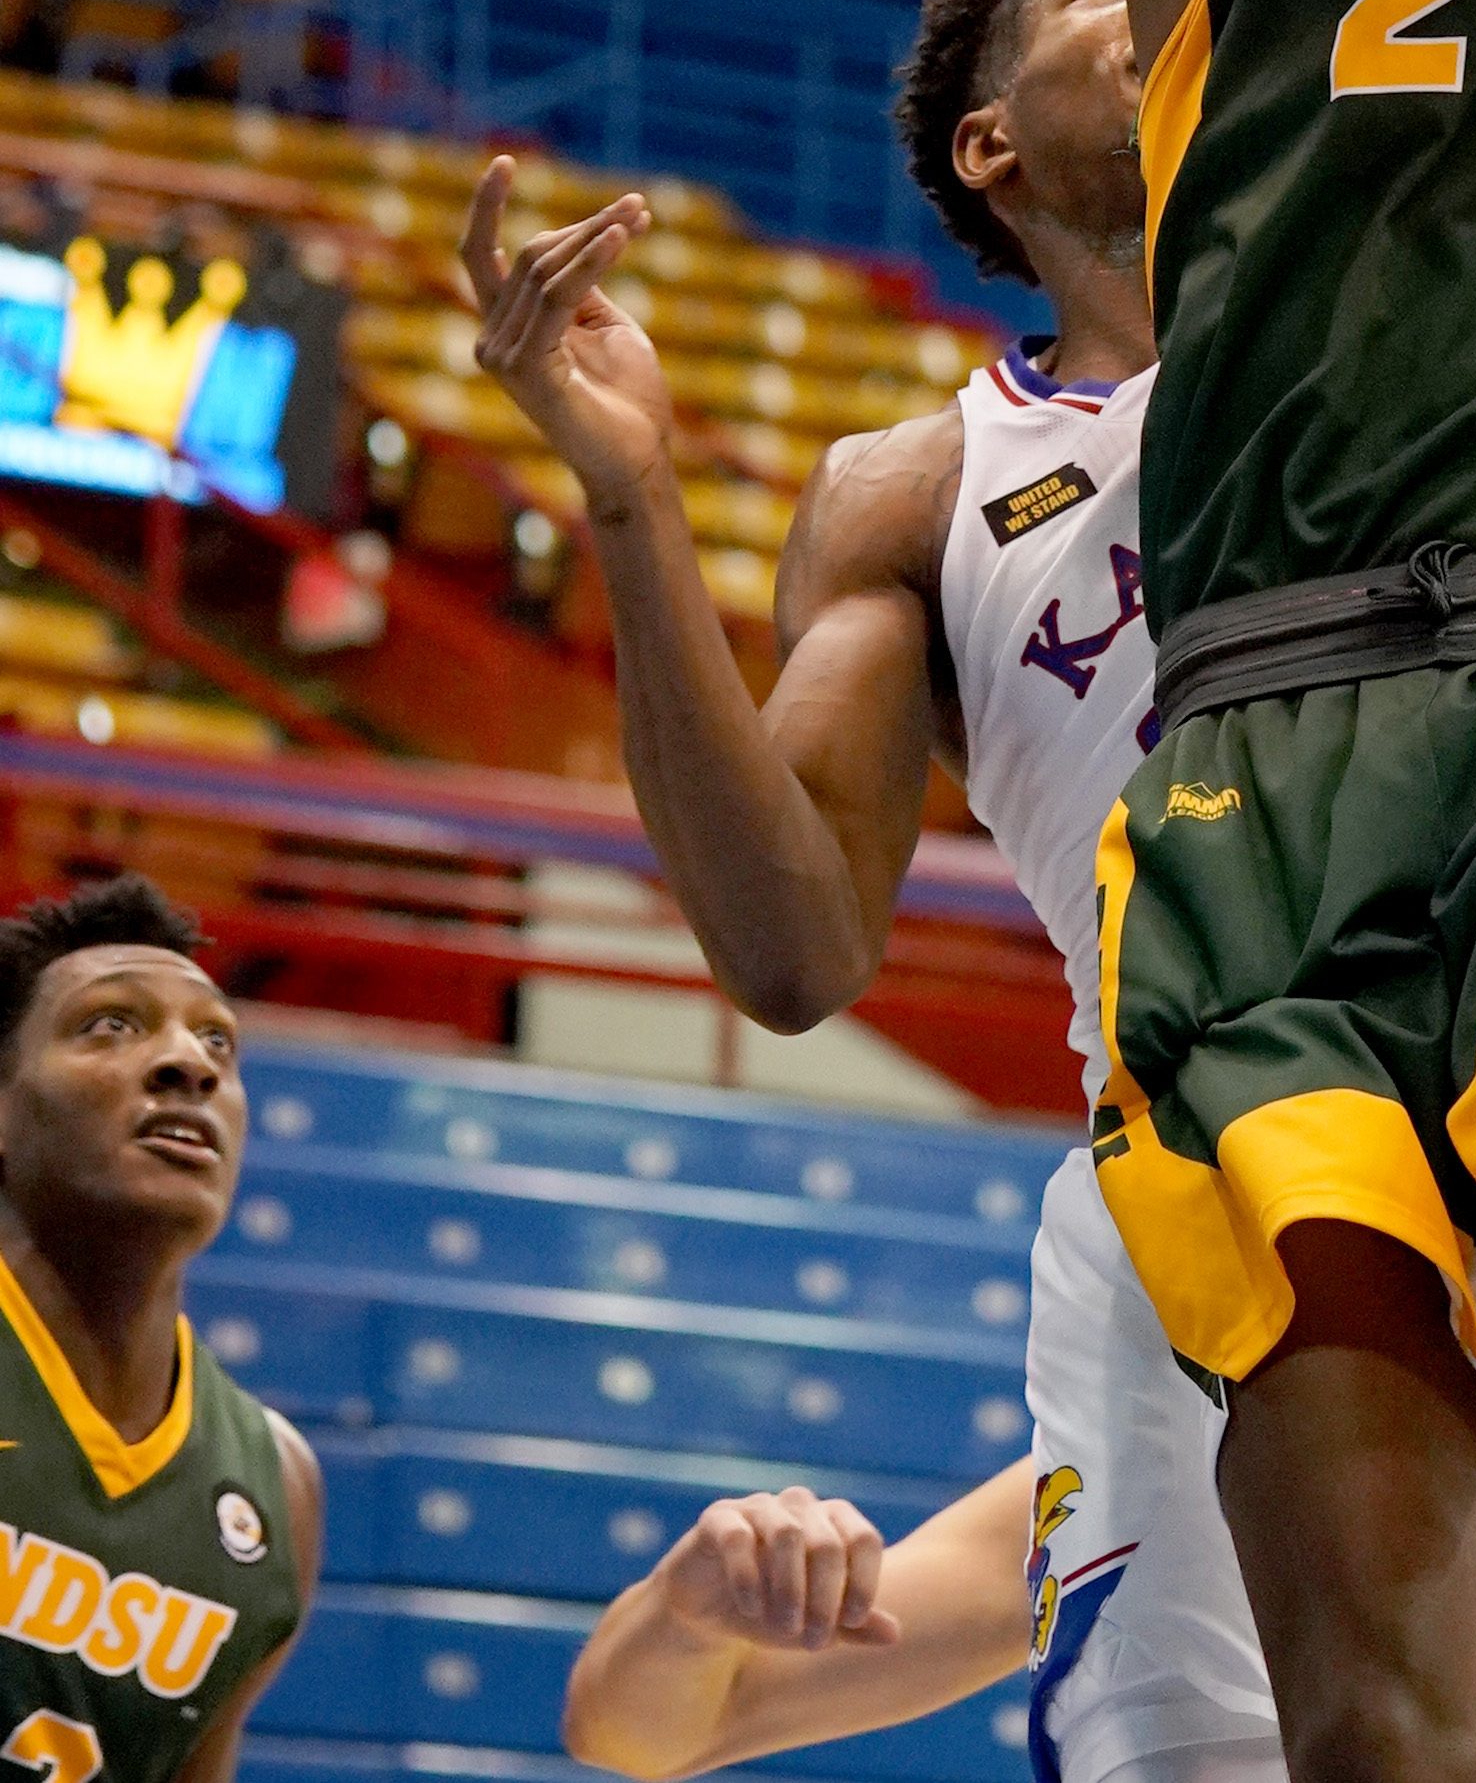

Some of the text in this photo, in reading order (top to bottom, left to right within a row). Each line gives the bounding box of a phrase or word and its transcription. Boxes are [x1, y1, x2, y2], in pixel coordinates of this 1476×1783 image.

[1004, 484, 1080, 533] WE STAND
[1008, 476, 1062, 513] UNITED
